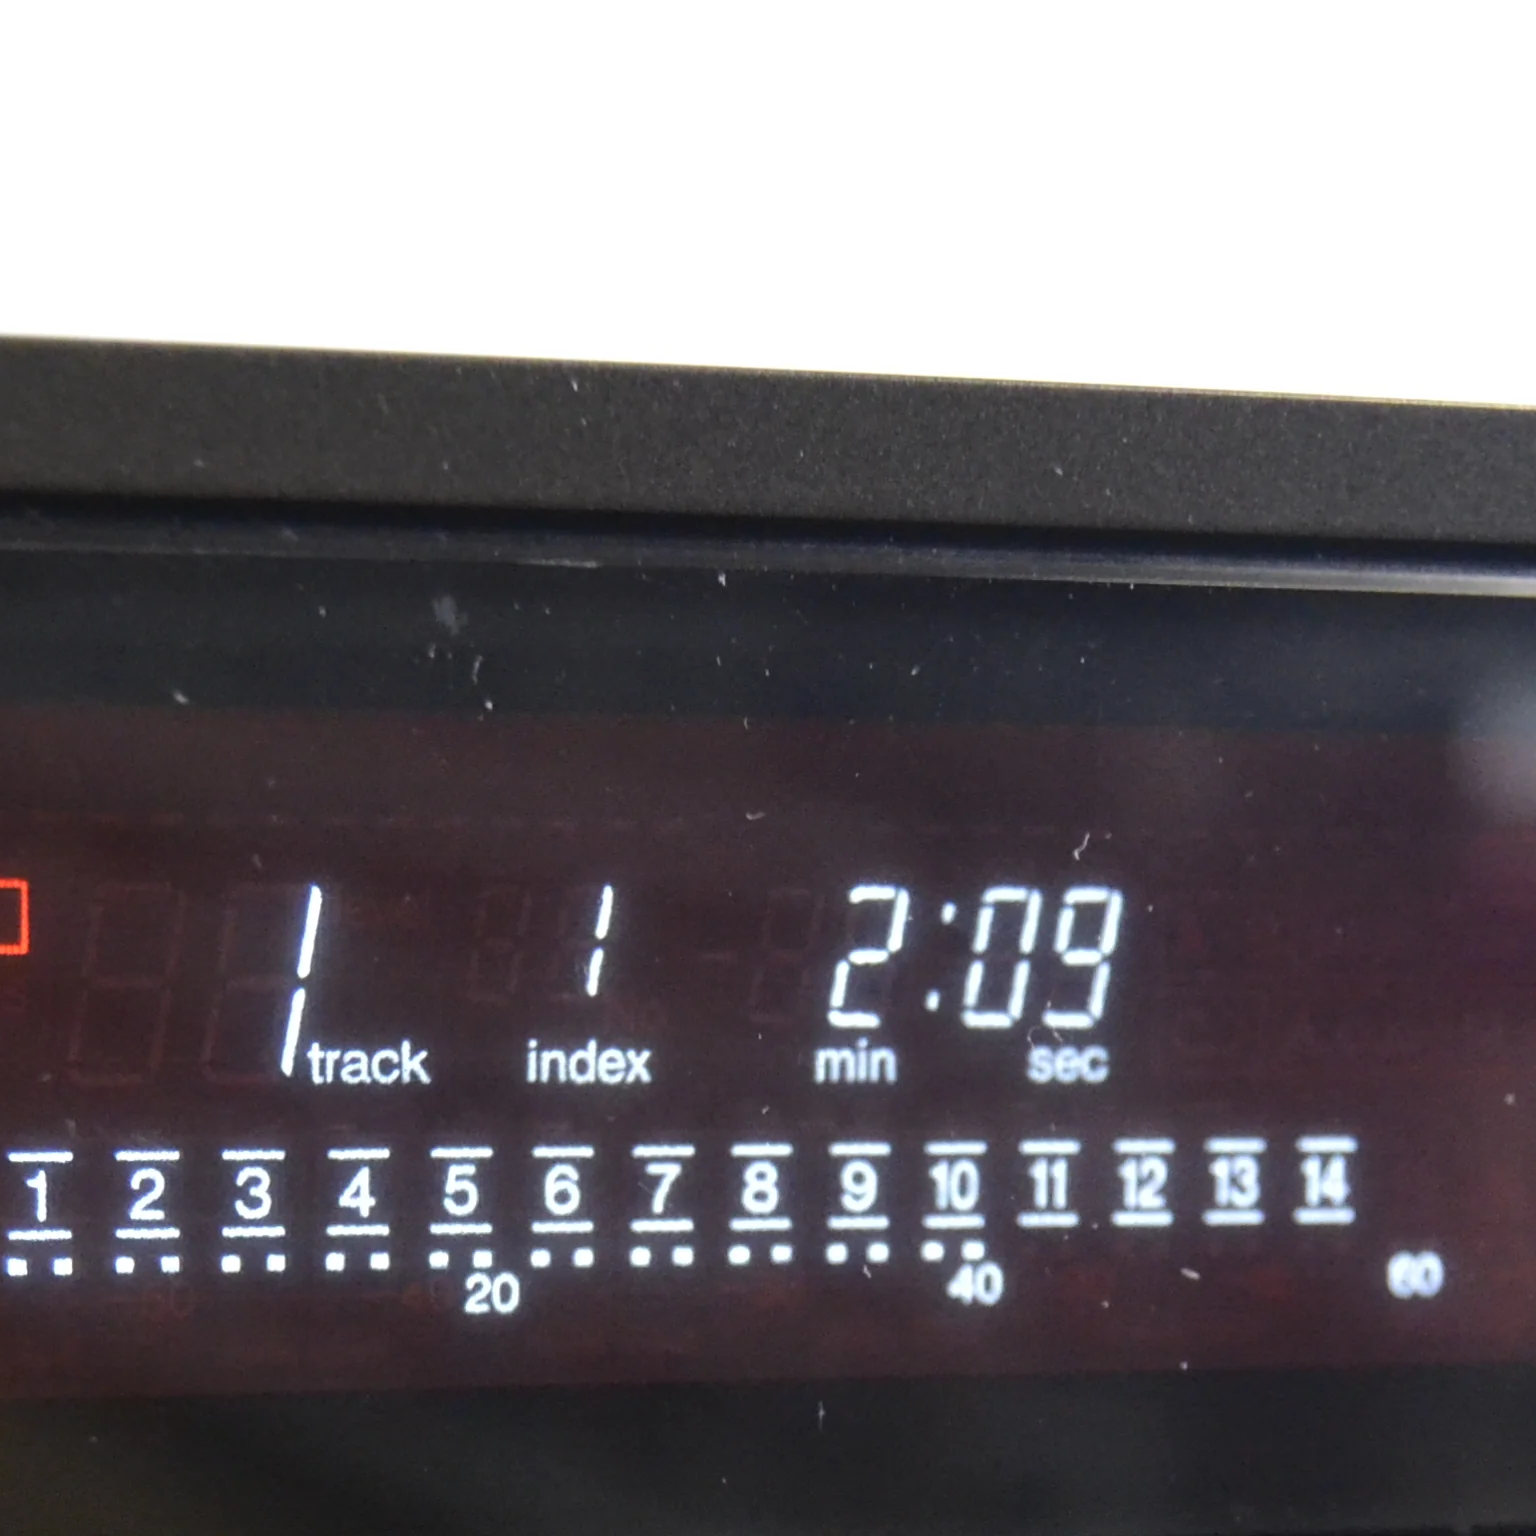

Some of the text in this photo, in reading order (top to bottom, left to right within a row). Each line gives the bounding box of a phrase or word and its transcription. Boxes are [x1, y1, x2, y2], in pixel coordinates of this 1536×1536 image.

[584, 884, 615, 998] 1
[826, 883, 1124, 1031] 2:09
[305, 1039, 431, 1085] track
[526, 1038, 652, 1087] index
[814, 1036, 897, 1083] min
[1027, 1045, 1109, 1084] sec
[25, 1168, 48, 1223] 1
[128, 1165, 166, 1222] 2
[234, 1165, 273, 1221] 3
[338, 1165, 377, 1219] 4
[442, 1162, 480, 1218] 5
[543, 1162, 582, 1218] 6
[645, 1161, 683, 1216] 7
[741, 1159, 780, 1214] 8
[840, 1157, 879, 1214] 9
[929, 1157, 980, 1213] 10
[1029, 1157, 1068, 1209] 11
[1118, 1153, 1168, 1207] 12
[1210, 1152, 1260, 1207] 13
[1301, 1151, 1351, 1205] 14
[463, 1265, 521, 1315] 20
[946, 1265, 1005, 1306] 40
